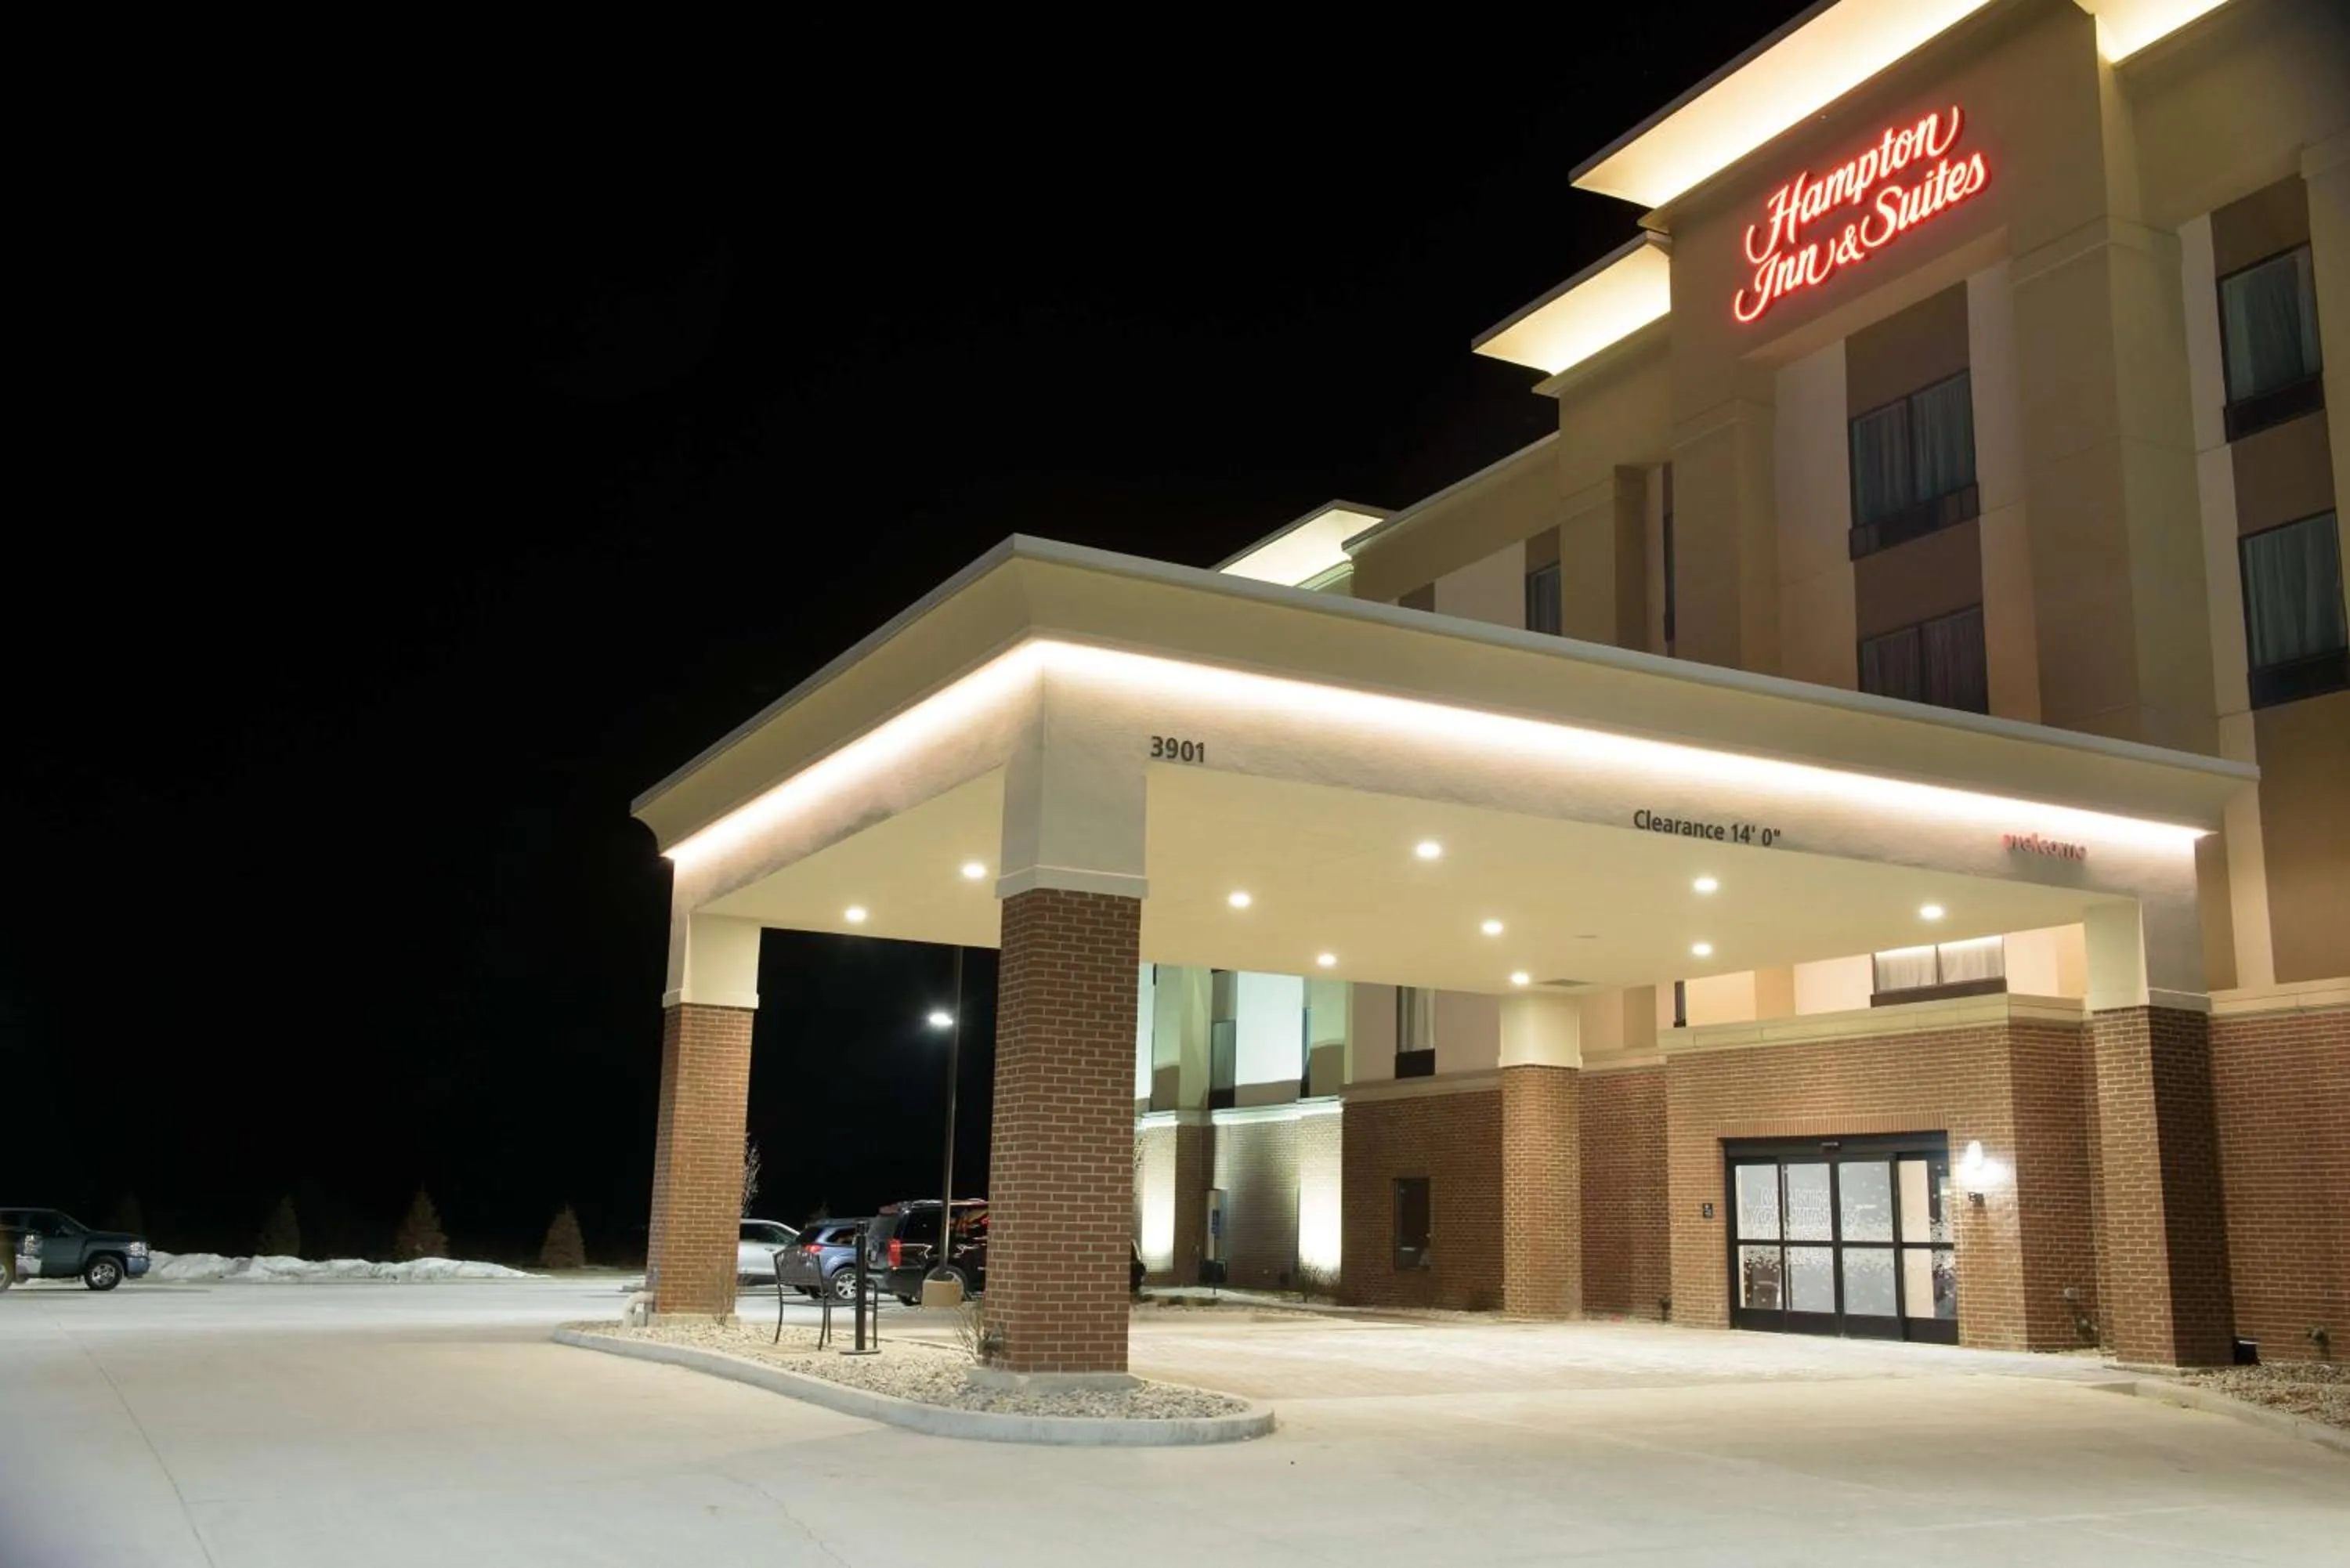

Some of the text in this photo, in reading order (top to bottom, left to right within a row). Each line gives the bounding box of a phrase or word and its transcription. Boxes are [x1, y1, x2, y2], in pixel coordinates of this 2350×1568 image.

[1745, 105, 1962, 265] Hampton
[1734, 152, 1987, 323] Inn & Suites
[1150, 735, 1205, 764] 3901
[1632, 809, 1725, 841] Clearance
